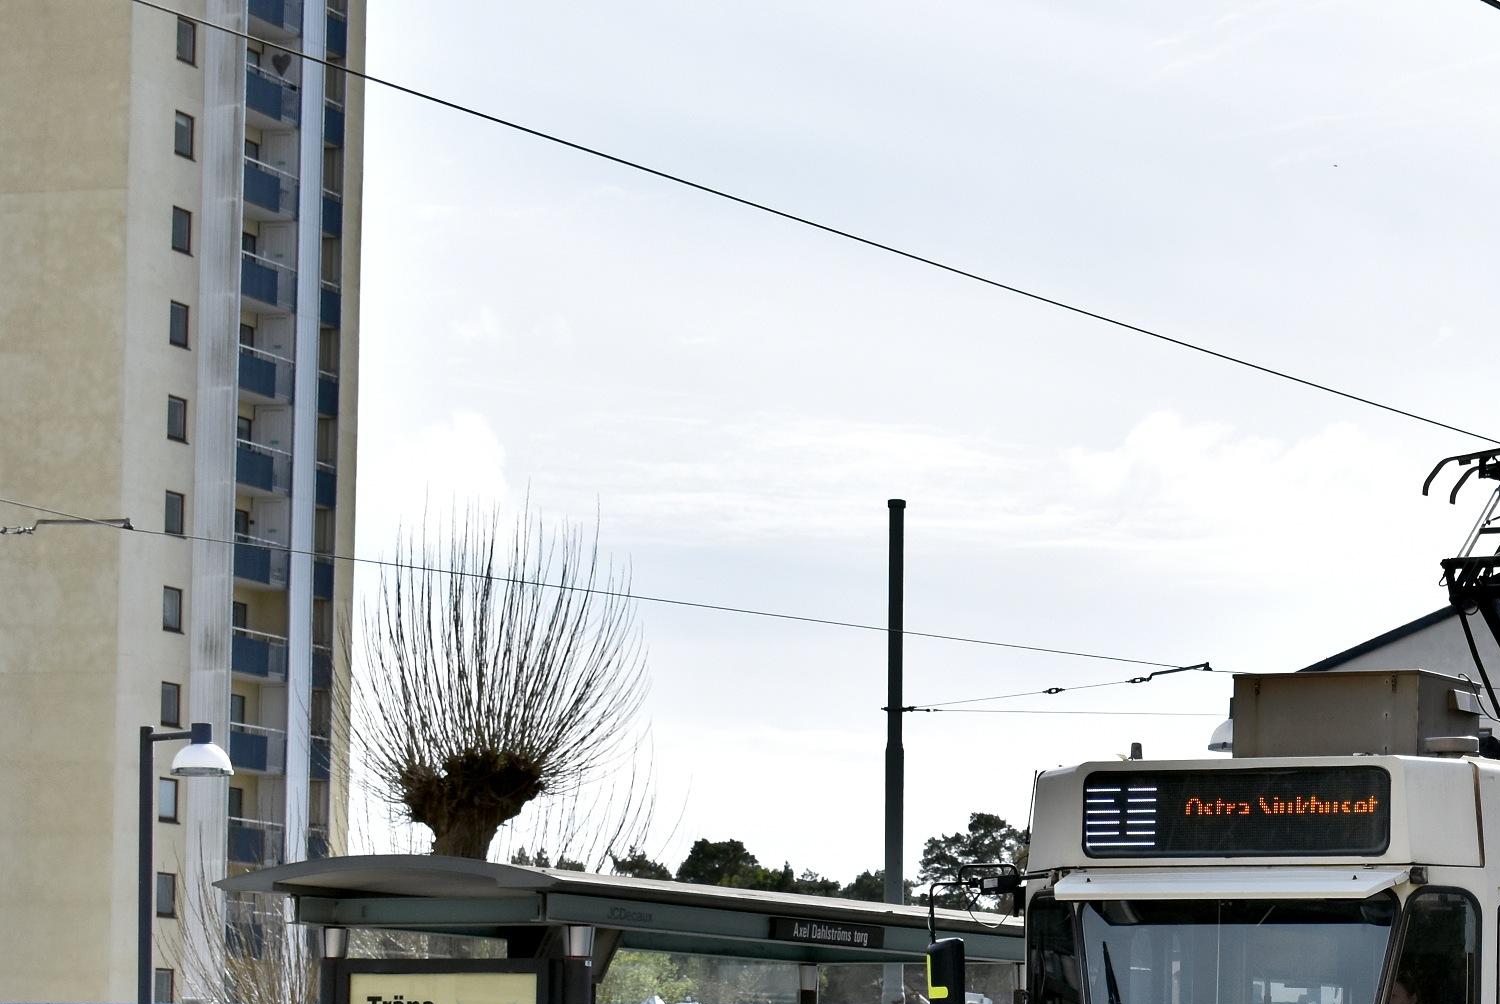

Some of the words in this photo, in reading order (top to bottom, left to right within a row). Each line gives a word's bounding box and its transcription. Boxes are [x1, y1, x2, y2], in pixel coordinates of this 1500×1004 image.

[793, 922, 810, 938] Axel
[812, 924, 852, 942] Dahlströms
[854, 930, 869, 947] torg
